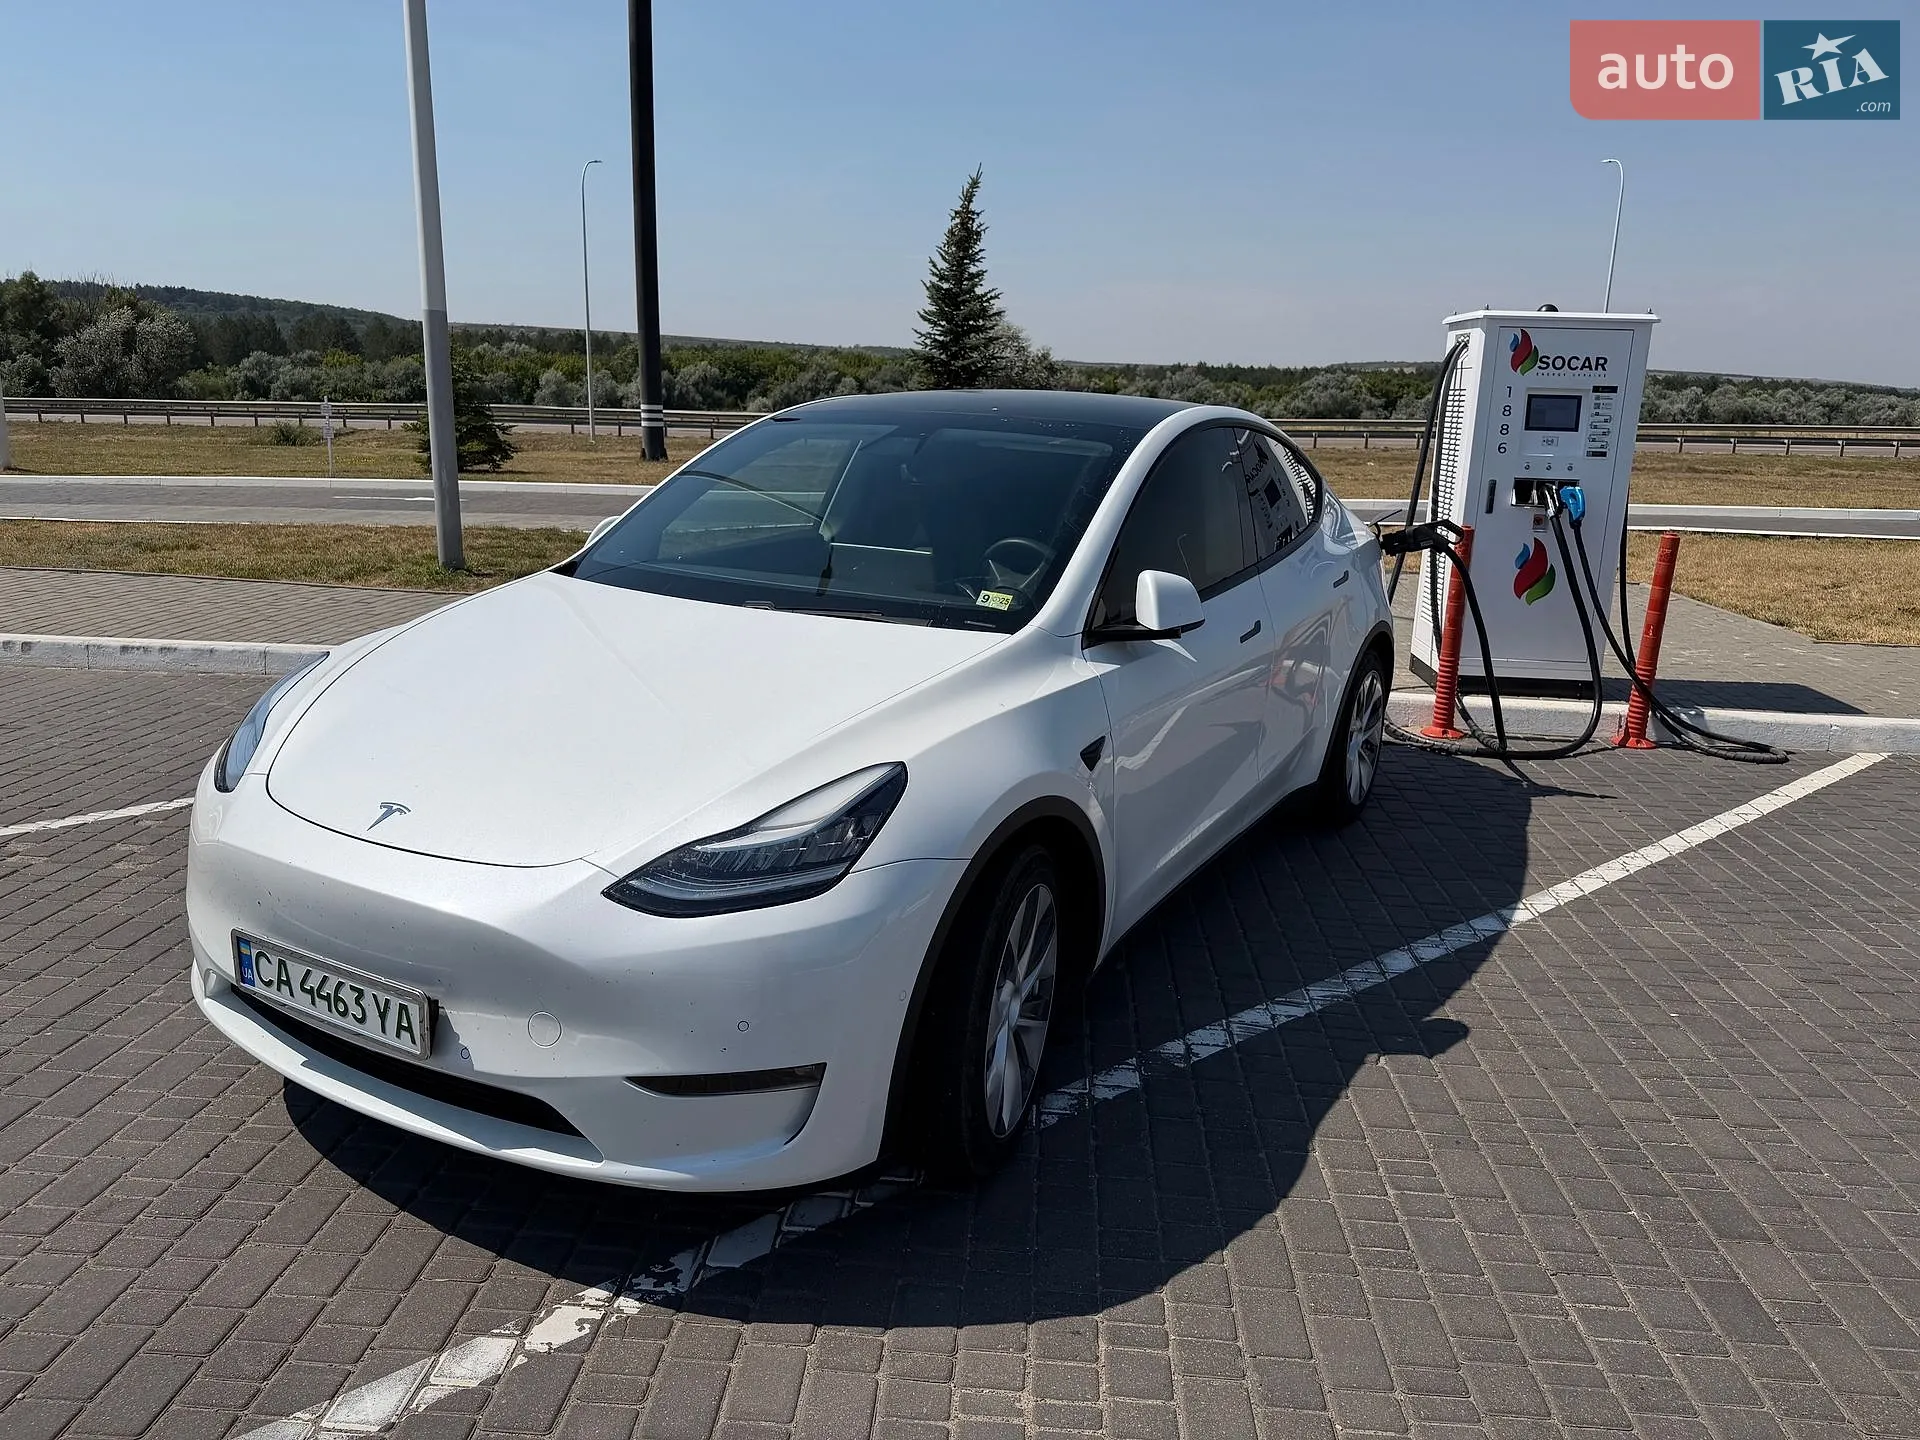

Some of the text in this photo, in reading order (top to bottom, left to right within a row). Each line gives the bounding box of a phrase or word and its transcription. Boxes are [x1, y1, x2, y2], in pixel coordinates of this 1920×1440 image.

[1537, 355, 1608, 372] SOCAR
[981, 594, 990, 603] 9
[242, 966, 254, 981] UA
[254, 950, 417, 1045] CA 4463 YA
